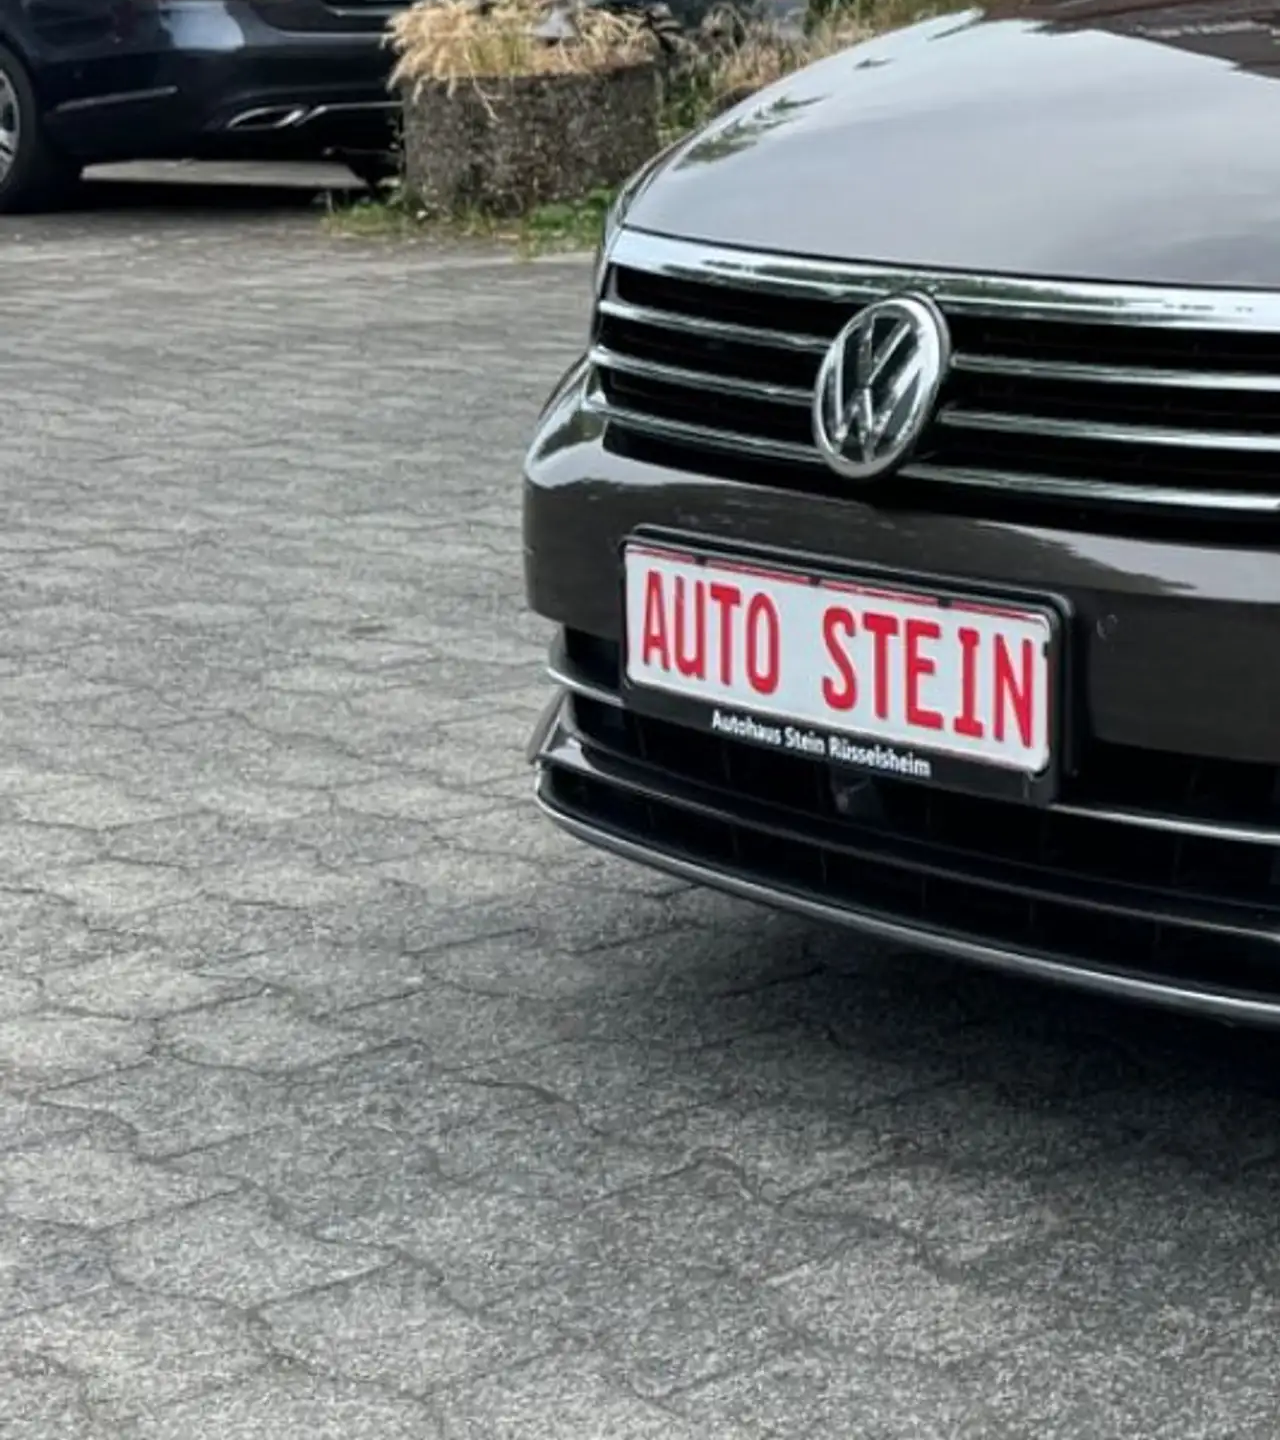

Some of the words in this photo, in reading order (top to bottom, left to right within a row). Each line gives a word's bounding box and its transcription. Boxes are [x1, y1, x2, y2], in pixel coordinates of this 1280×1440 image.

[643, 570, 780, 695] AUTO
[822, 606, 1035, 748] STEIN
[712, 709, 782, 745] Autohaus
[784, 726, 825, 755] Stein
[828, 735, 932, 778] Rüsselsheim
